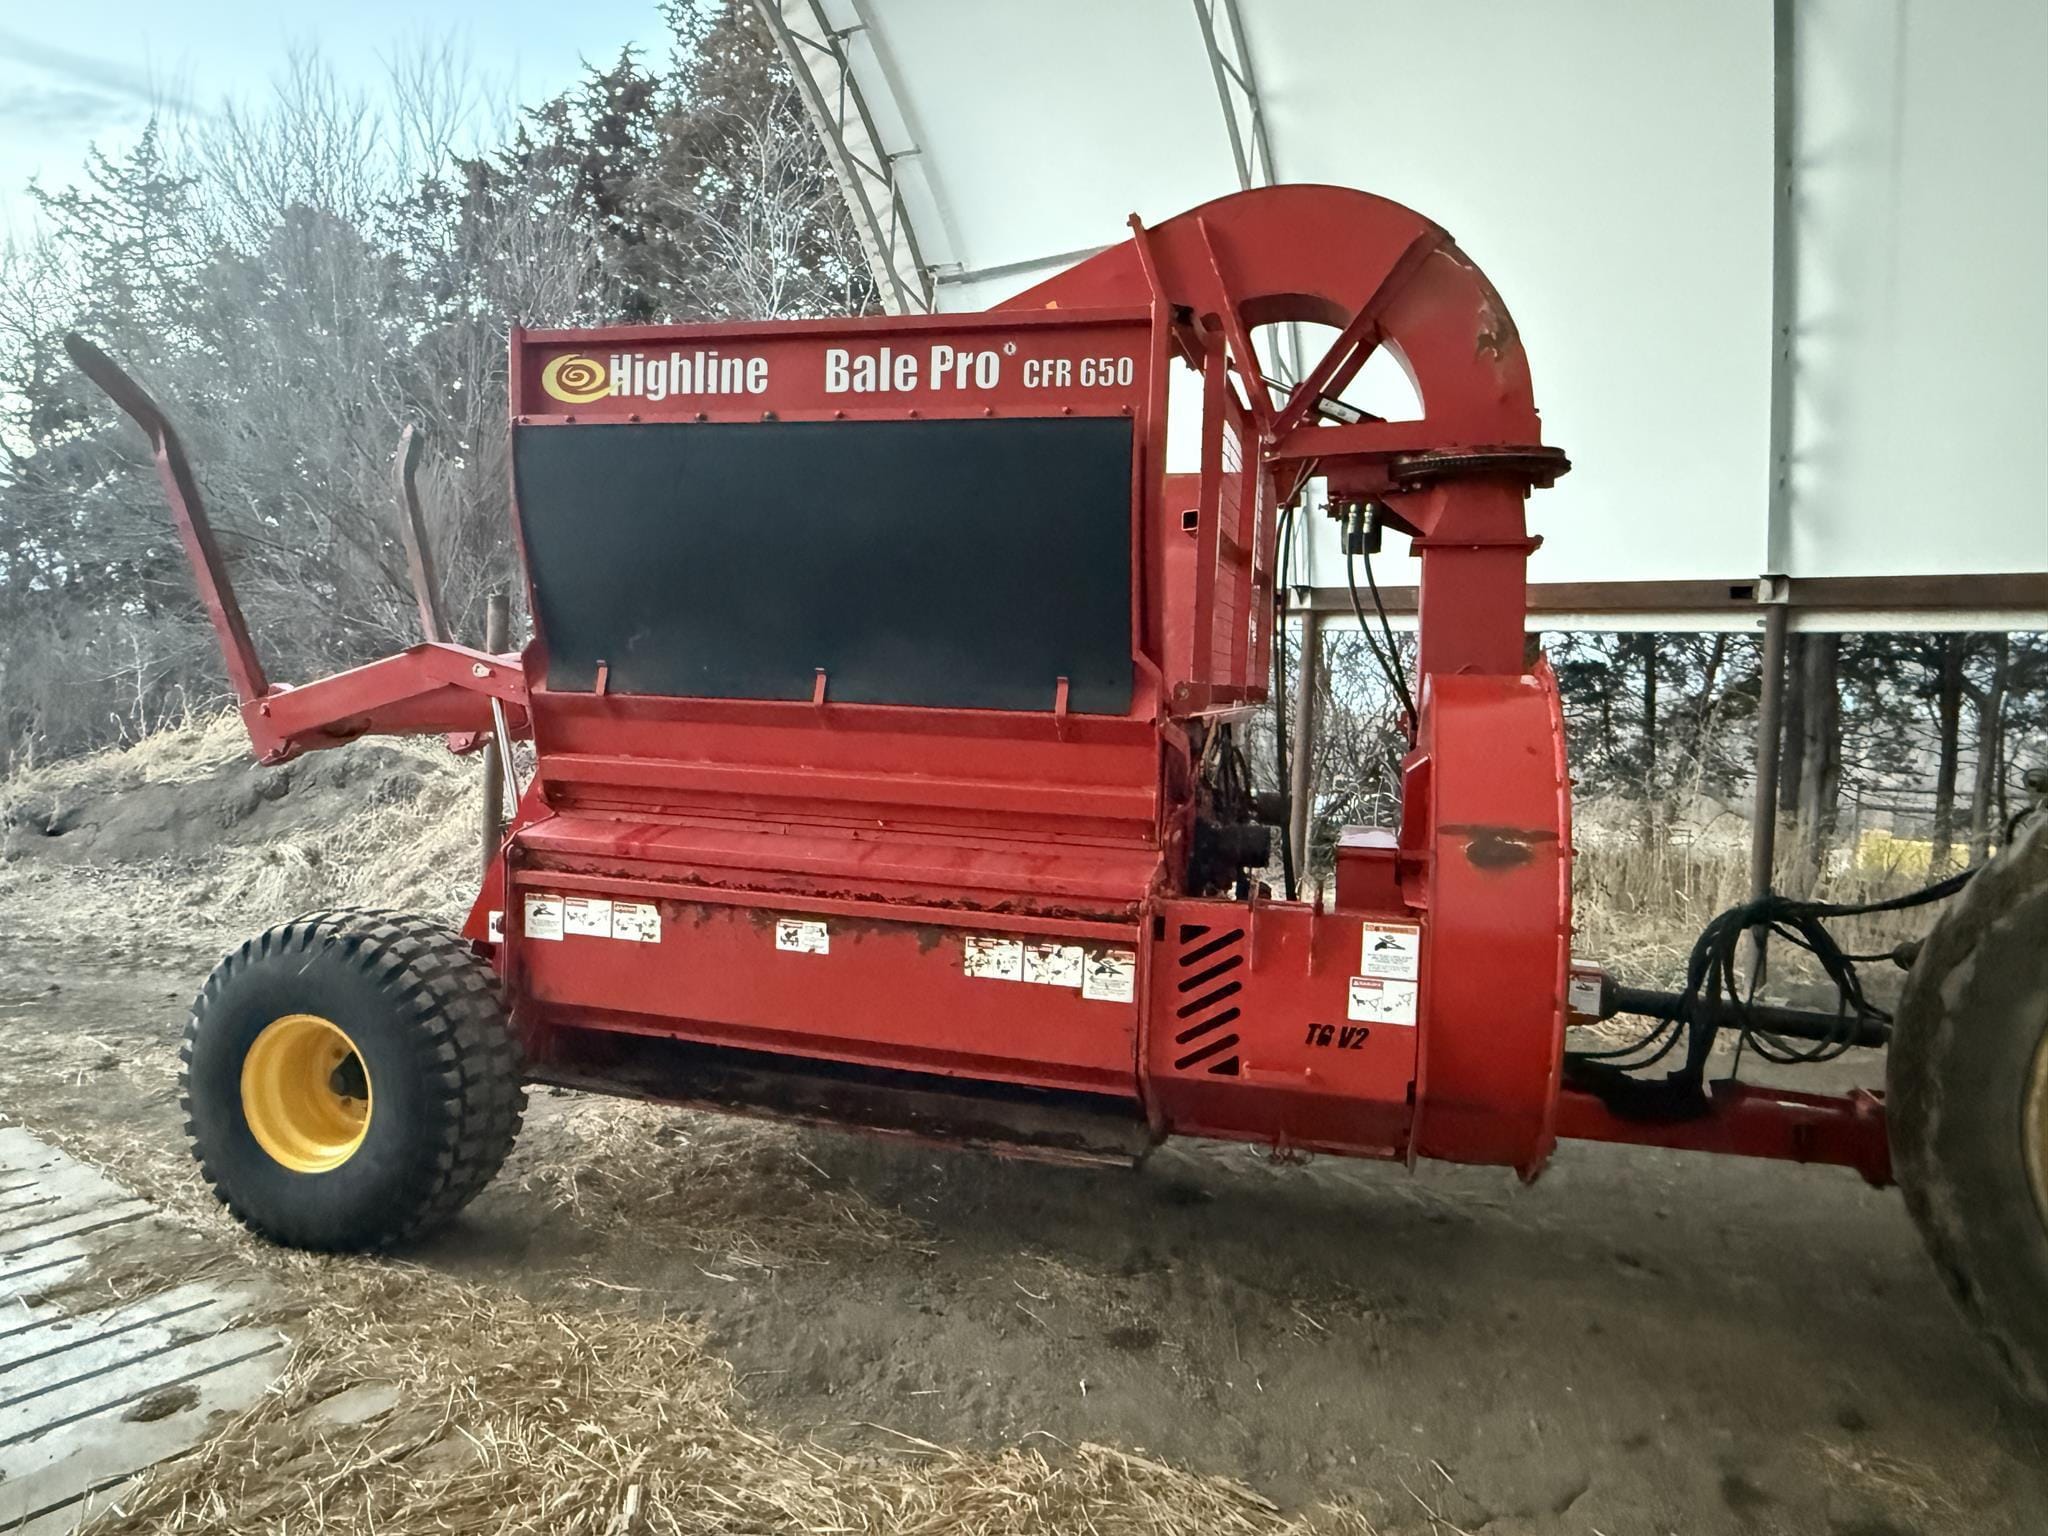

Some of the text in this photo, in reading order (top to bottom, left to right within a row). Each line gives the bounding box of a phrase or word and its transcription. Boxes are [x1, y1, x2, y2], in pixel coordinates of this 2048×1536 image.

[610, 351, 768, 401] Highline
[825, 345, 1133, 393] Bale Pro CFR 650
[1338, 1026, 1370, 1049] V2
